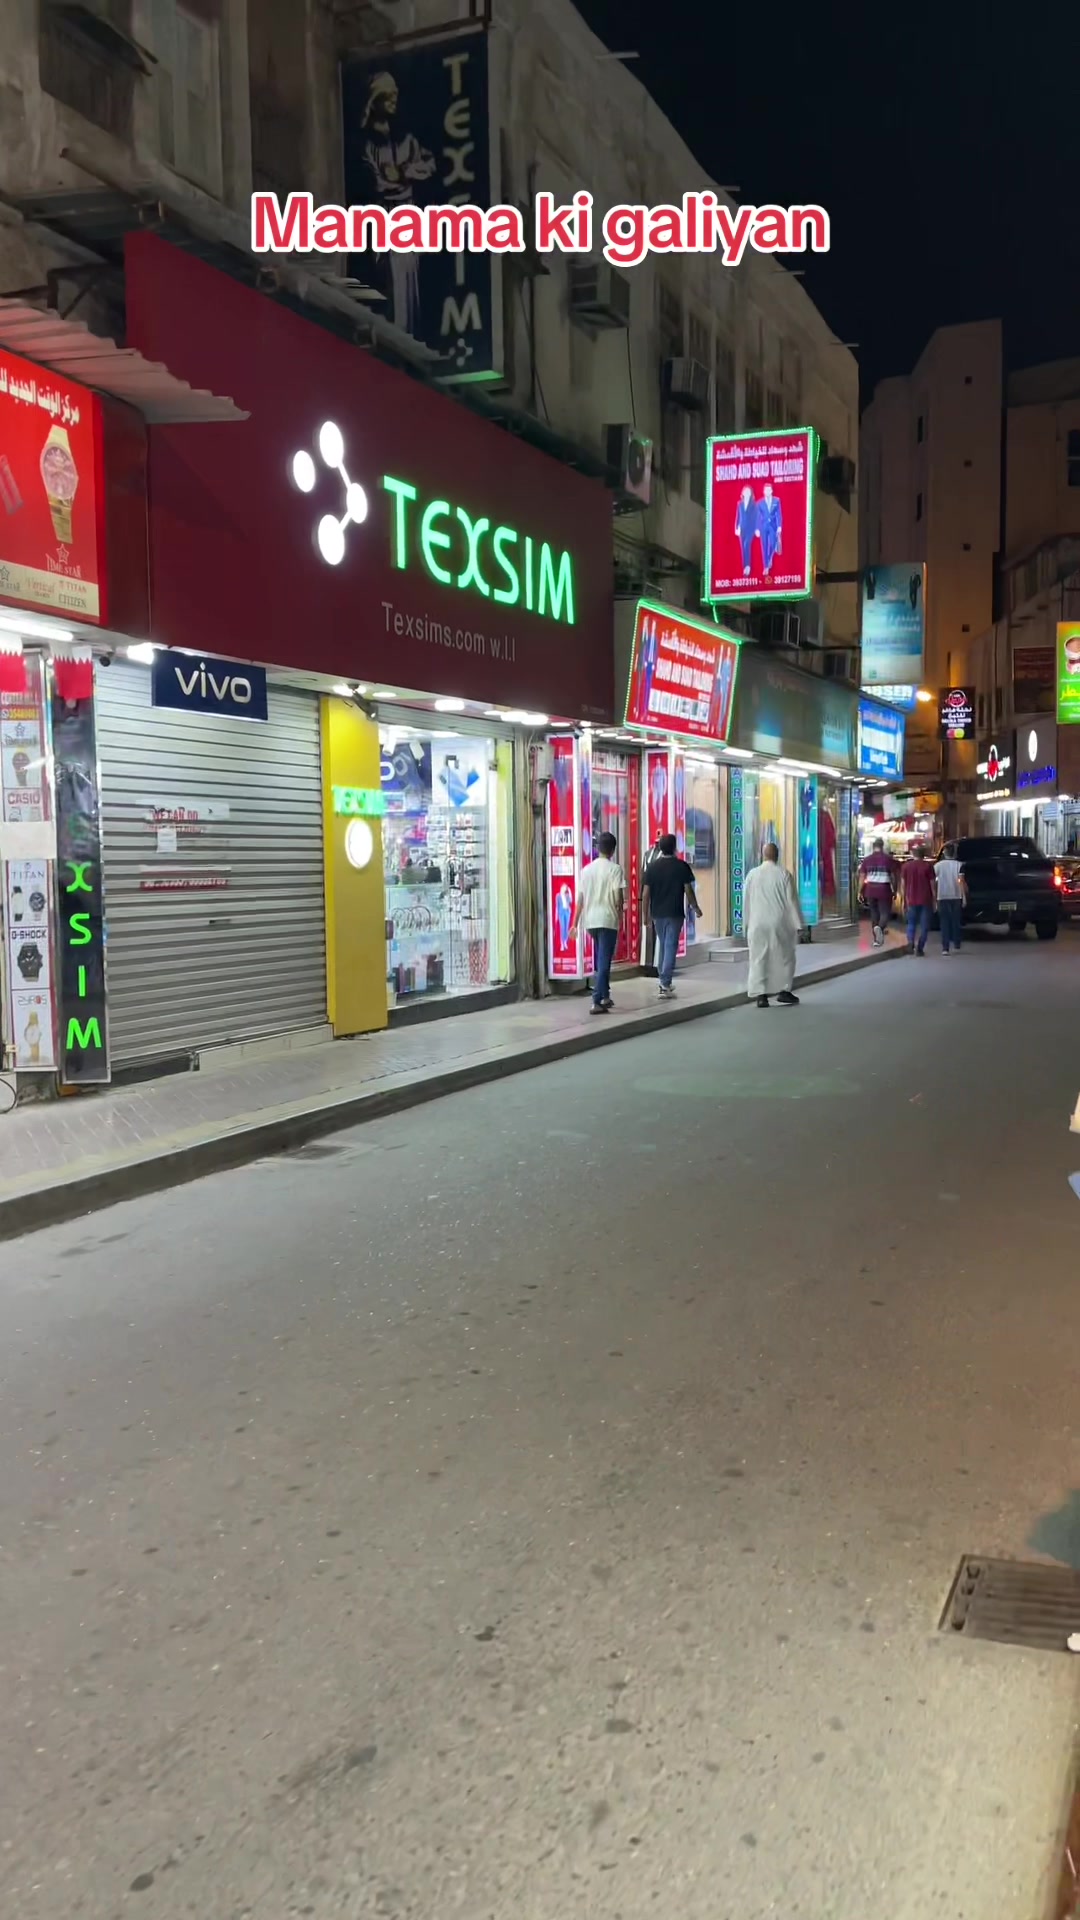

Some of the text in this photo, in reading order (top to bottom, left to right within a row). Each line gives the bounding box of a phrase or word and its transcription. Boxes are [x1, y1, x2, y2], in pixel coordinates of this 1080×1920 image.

[443, 52, 483, 336] TEXIM
[715, 457, 804, 482] SHAHD AND SUAD TAILORING
[384, 475, 574, 624] TEXSIM
[382, 601, 485, 654] Texsims.com
[174, 661, 252, 704] vivo
[7, 792, 41, 805] CASIO
[11, 871, 46, 879] TITAN
[732, 811, 743, 933] TAILORING
[12, 930, 47, 940] G-SHOCK
